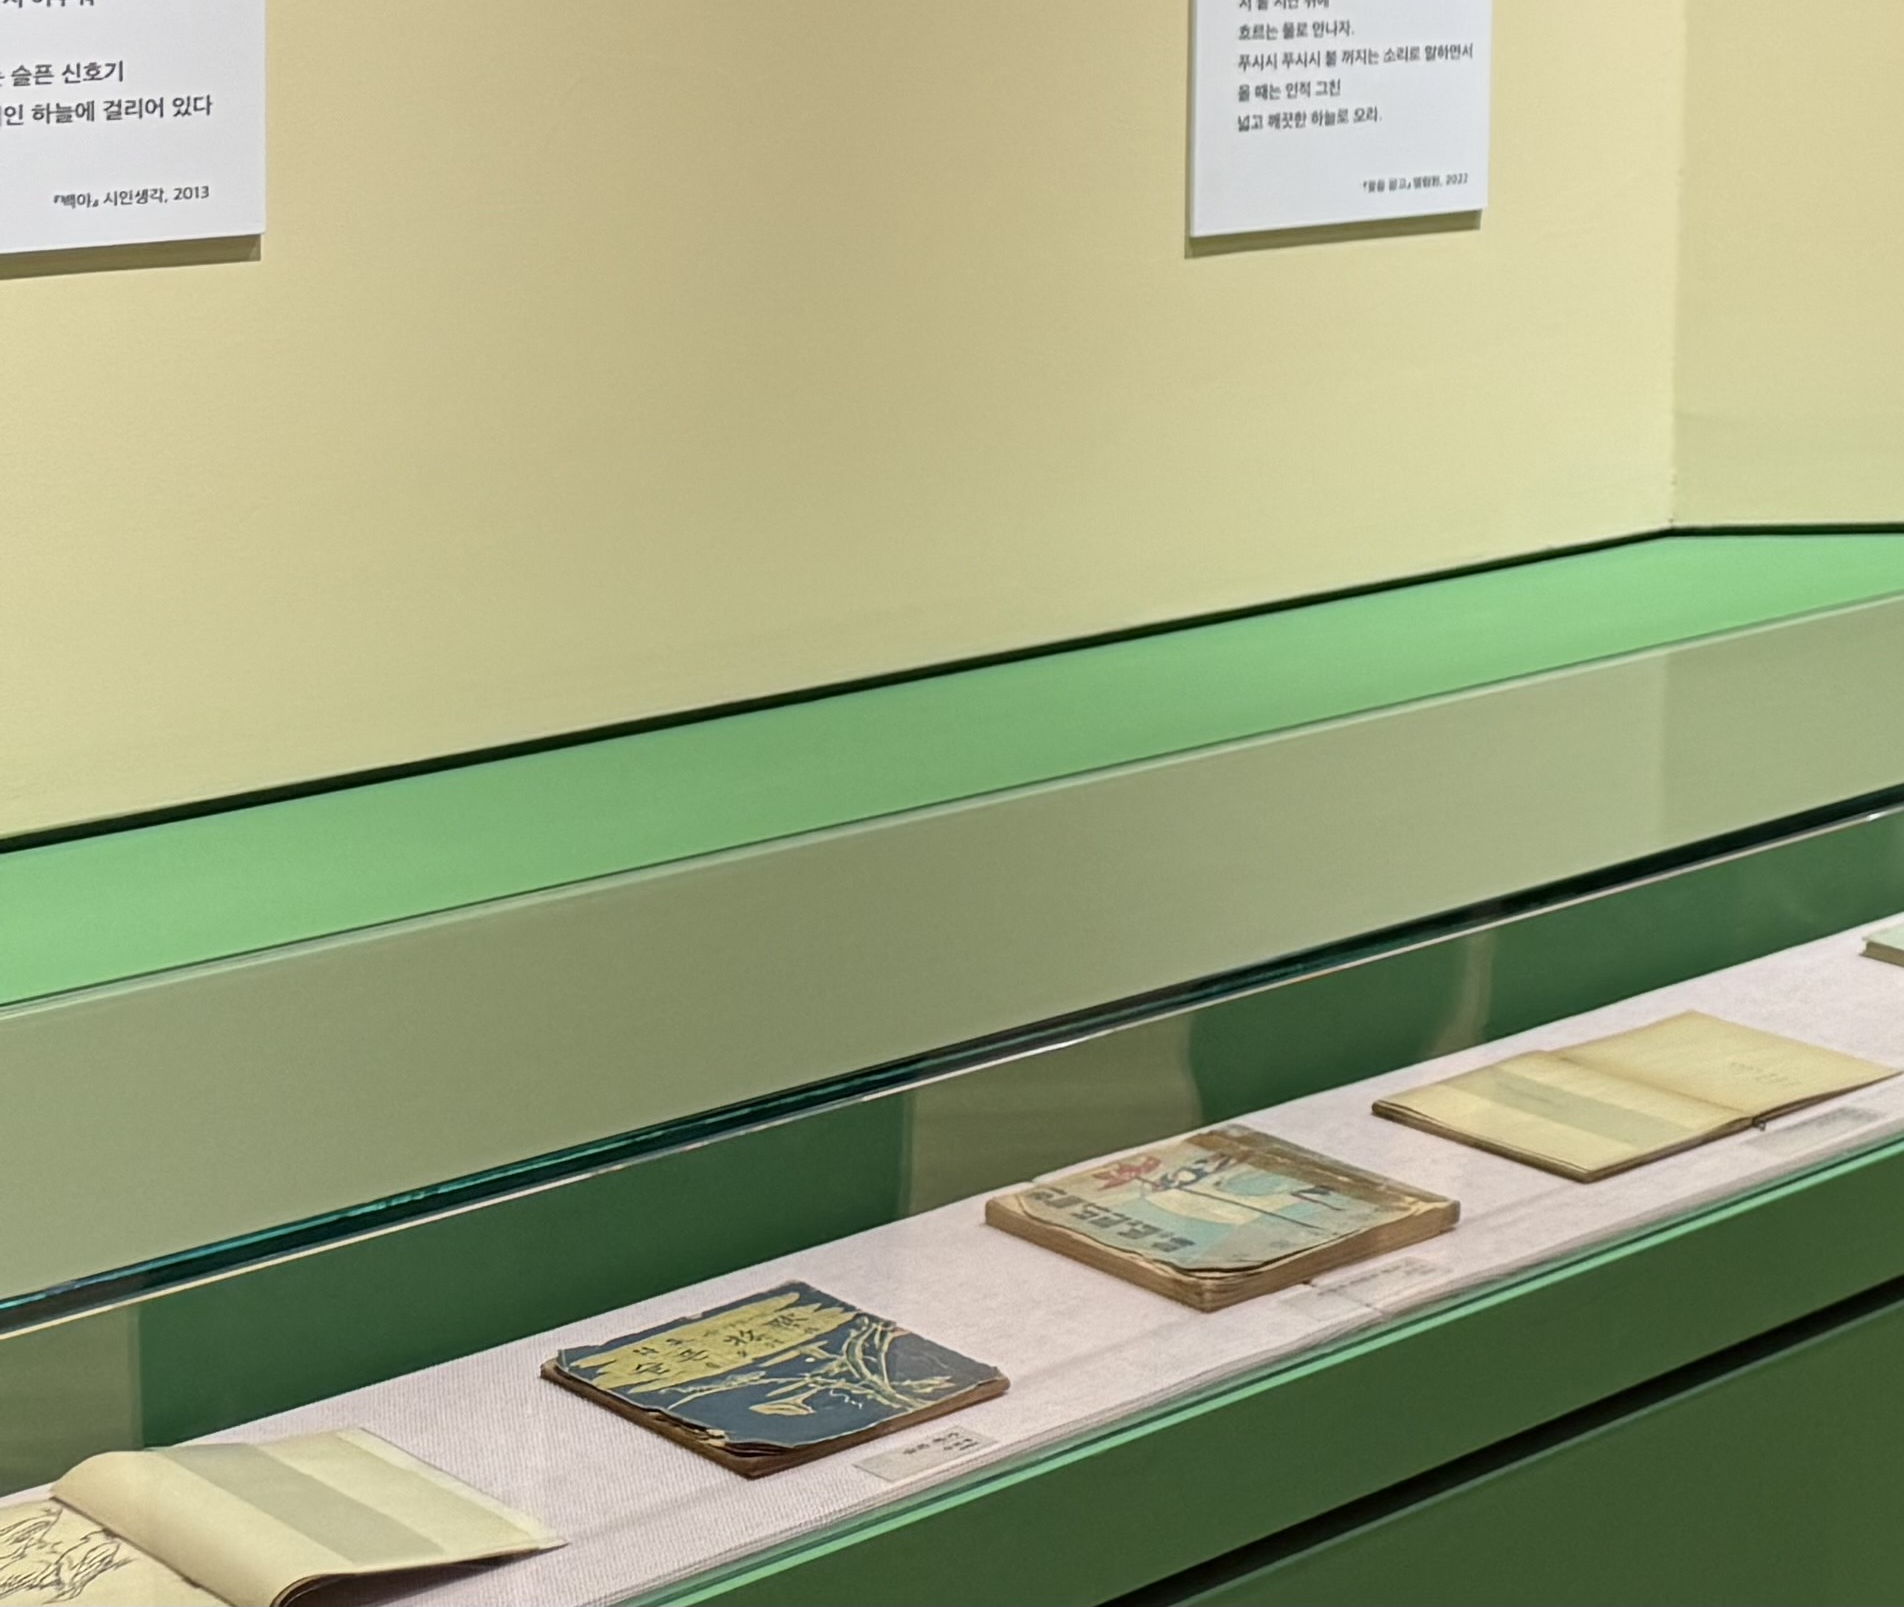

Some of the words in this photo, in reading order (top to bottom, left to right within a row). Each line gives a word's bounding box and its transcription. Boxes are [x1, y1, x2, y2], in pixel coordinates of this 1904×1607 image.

[8, 64, 54, 87] 슬픈
[60, 60, 123, 84] 신호기
[30, 100, 95, 124] 하늘에
[102, 97, 164, 121] 걸리어
[171, 94, 213, 117] 있다
[102, 187, 168, 206] 시인생각,
[172, 186, 209, 200] 2013
